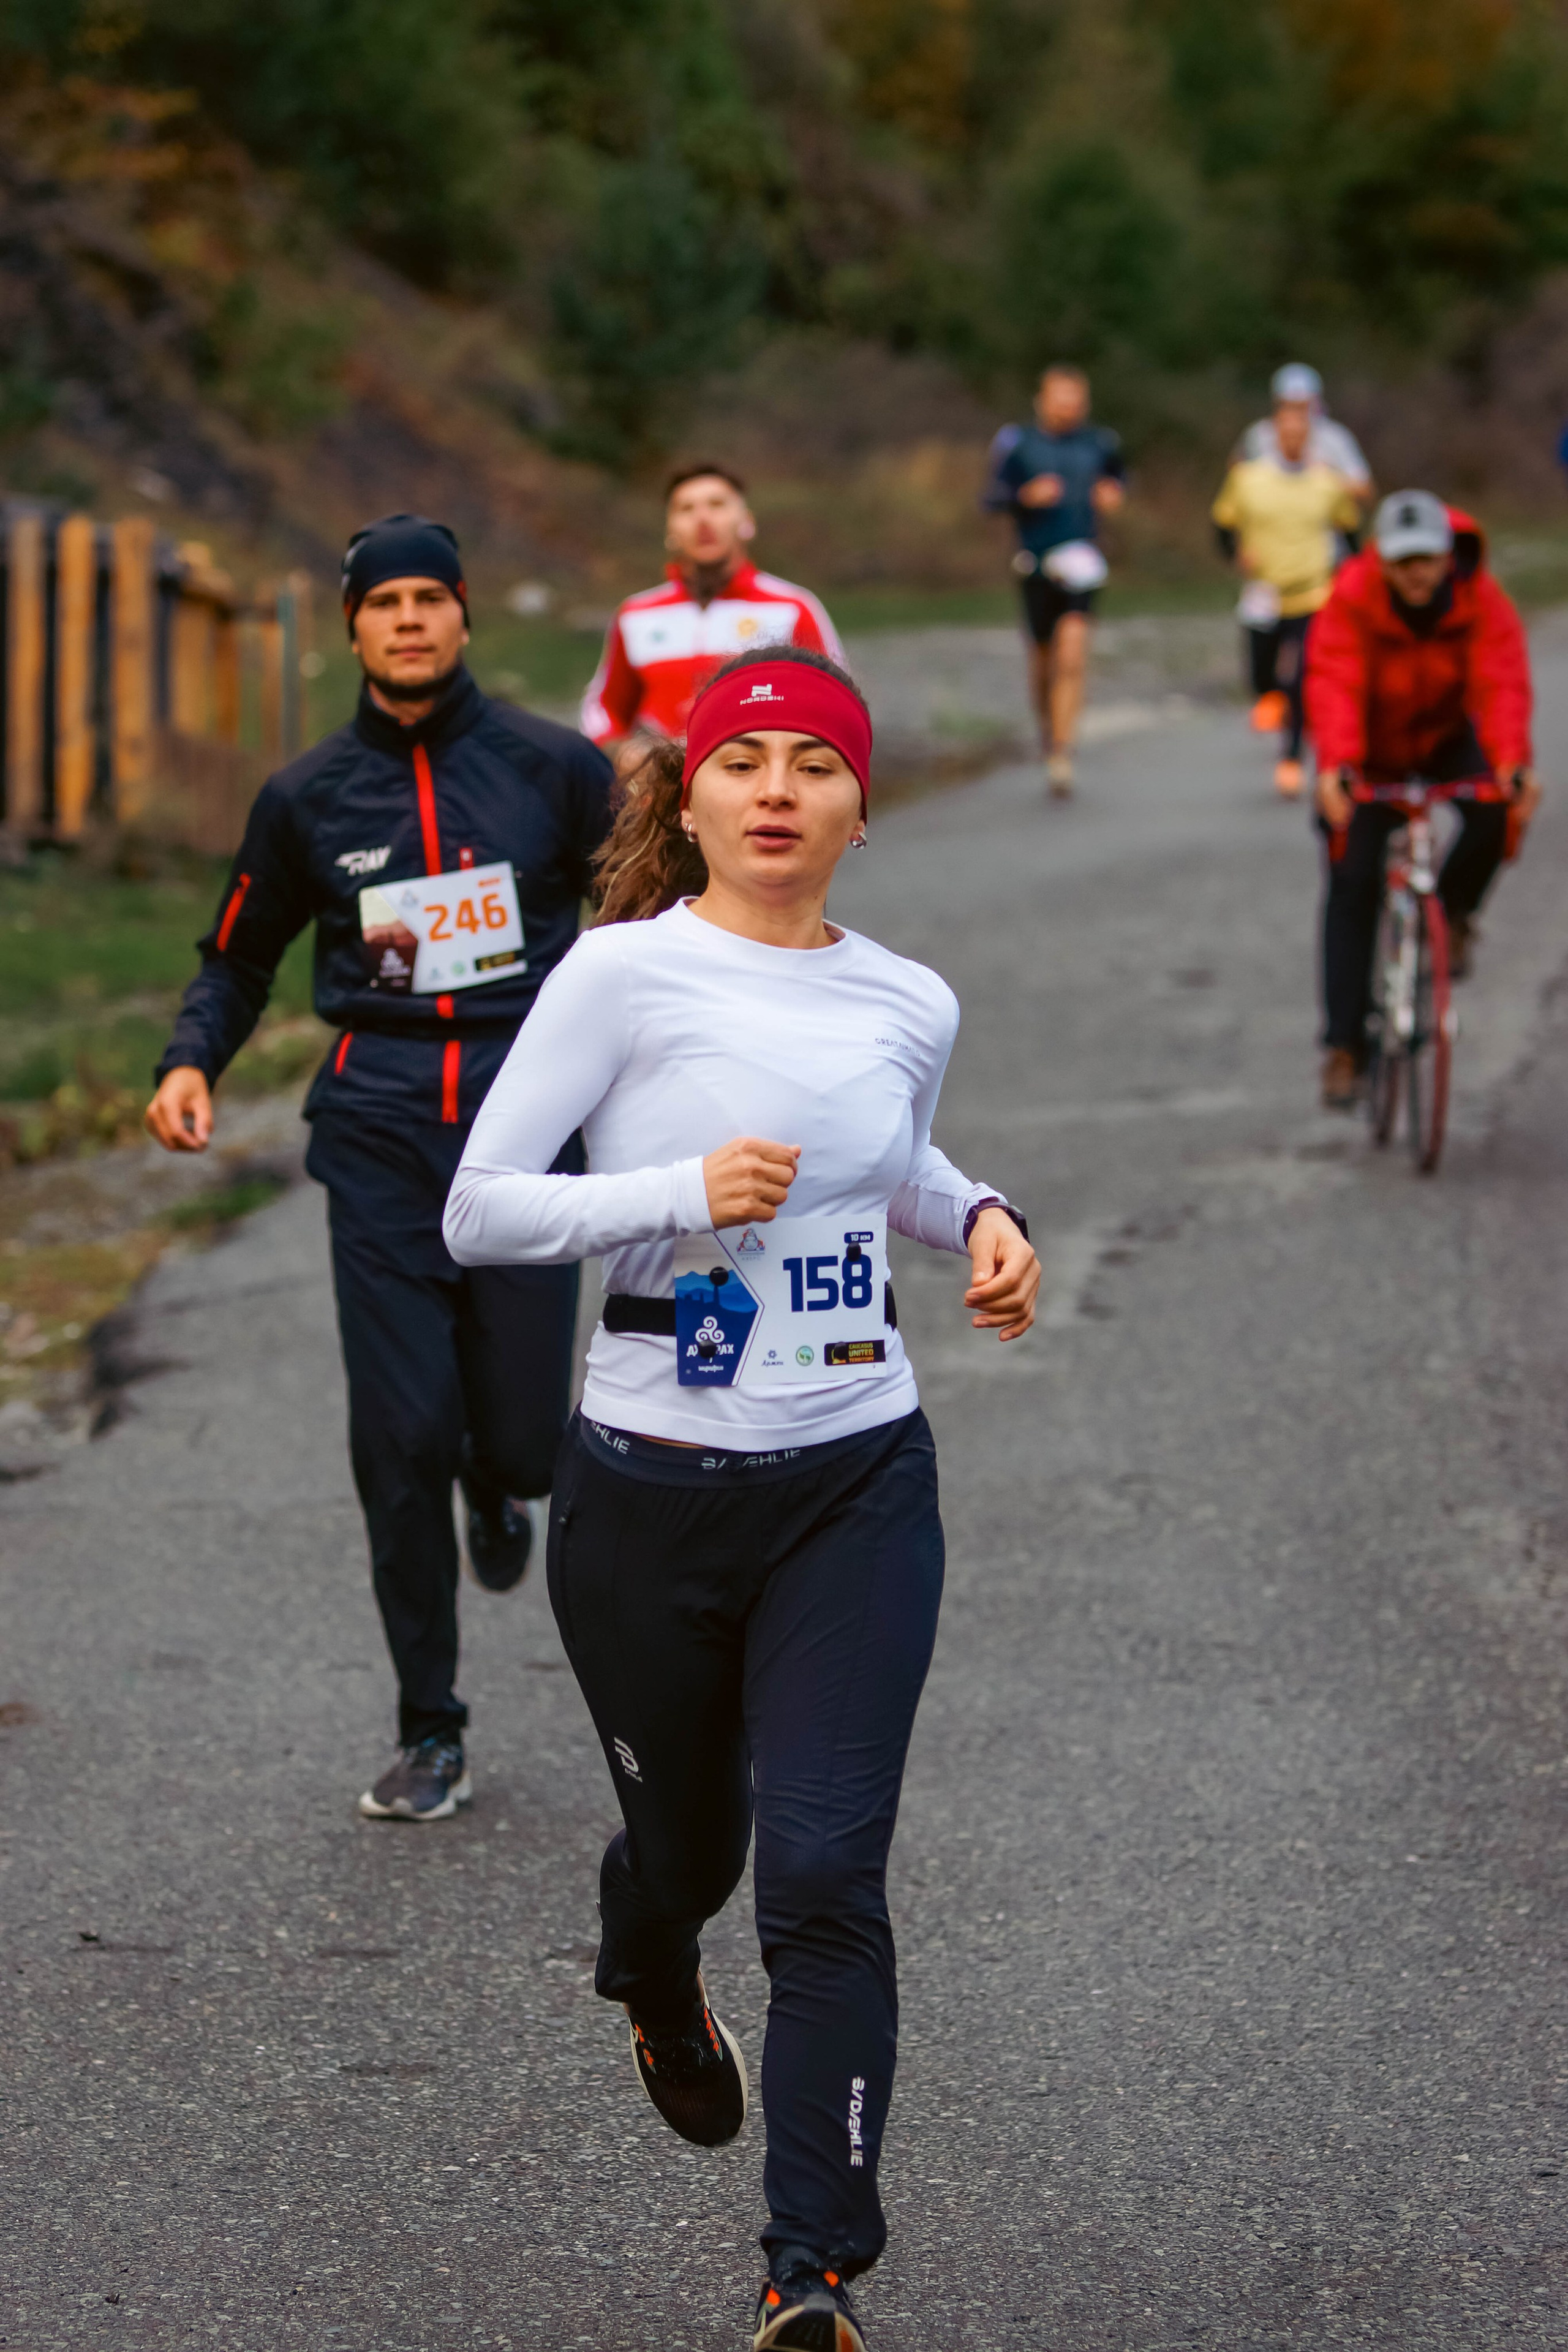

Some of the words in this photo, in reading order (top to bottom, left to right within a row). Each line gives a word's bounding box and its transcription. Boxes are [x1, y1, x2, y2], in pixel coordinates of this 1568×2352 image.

[740, 695, 784, 706] NORDSKI
[423, 892, 508, 942] 246
[783, 1254, 872, 1312] 158
[848, 1348, 874, 1357] UNITED
